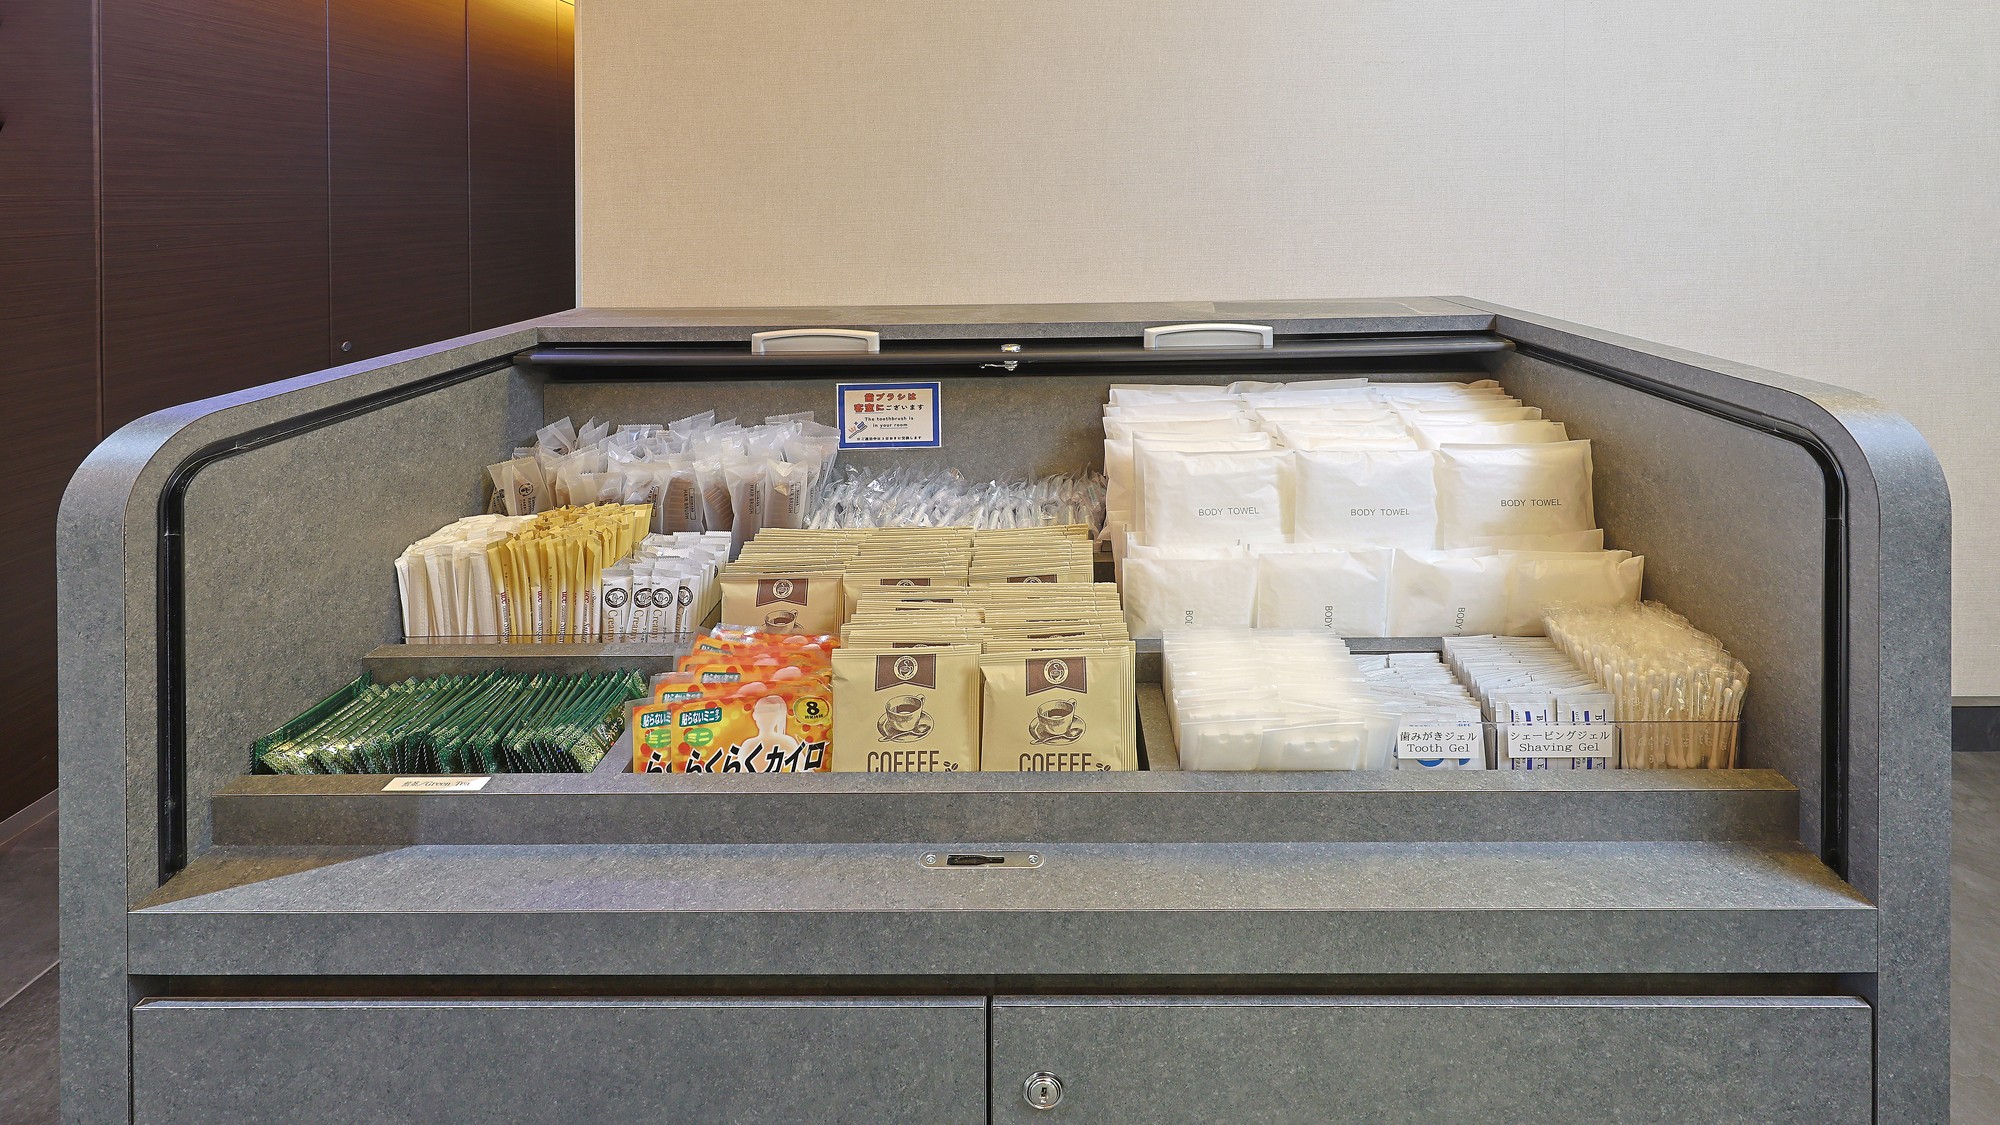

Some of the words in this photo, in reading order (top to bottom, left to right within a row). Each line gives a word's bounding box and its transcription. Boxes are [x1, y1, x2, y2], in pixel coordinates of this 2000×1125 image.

[864, 392, 917, 402] 歯ブラシは
[1500, 499, 1526, 507] BODY
[1531, 498, 1562, 506] TOWEL
[1199, 508, 1224, 516] BODY
[1228, 507, 1260, 515] TOWEL
[1350, 508, 1376, 516] BODY
[1380, 508, 1410, 516] TOWEL
[1324, 605, 1333, 628] BODY
[1455, 607, 1466, 630] BODY
[605, 610, 618, 642] Creamy
[627, 610, 644, 641] Creamy
[649, 609, 663, 641] Creamy
[806, 701, 820, 715] 8
[688, 732, 710, 742] ミニ
[1400, 731, 1477, 741] 歯みがきジェル
[1510, 730, 1611, 741] シェービングジェル
[1407, 744, 1443, 752] Tooth
[1449, 744, 1470, 752] Gel
[1519, 743, 1573, 752] Shaving
[1578, 743, 1600, 752] Gel
[685, 741, 829, 773] らくらくカイロ
[867, 750, 940, 772] COFFEE
[1019, 752, 1092, 772] COFFEE
